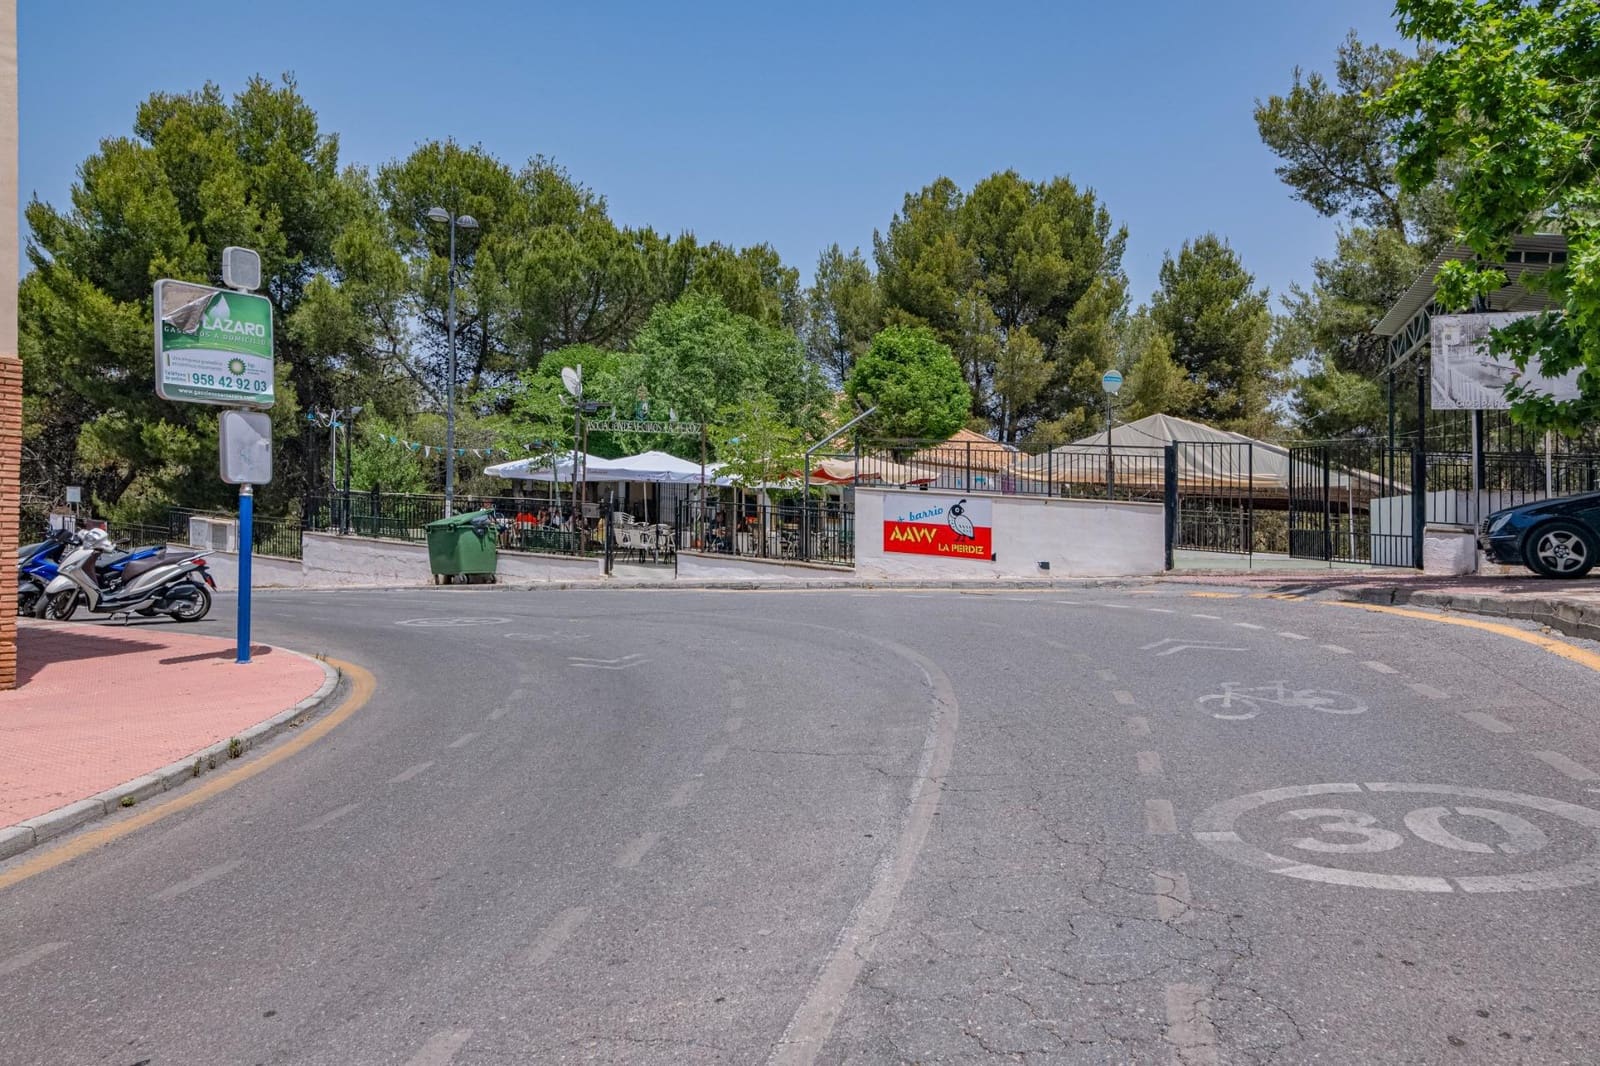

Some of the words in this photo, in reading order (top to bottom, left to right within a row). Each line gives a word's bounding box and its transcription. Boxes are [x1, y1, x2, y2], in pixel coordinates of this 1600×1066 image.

[203, 317, 265, 337] LAZARO
[223, 334, 266, 346] DOMICILIO
[192, 373, 215, 386] 958
[218, 376, 233, 388] 42
[236, 378, 251, 391] 92
[254, 380, 267, 392] 03
[909, 505, 944, 521] barrio
[890, 525, 937, 544] AAVV
[938, 543, 949, 552] LA
[951, 544, 984, 554] PERDIZ
[1278, 805, 1550, 854] 30
